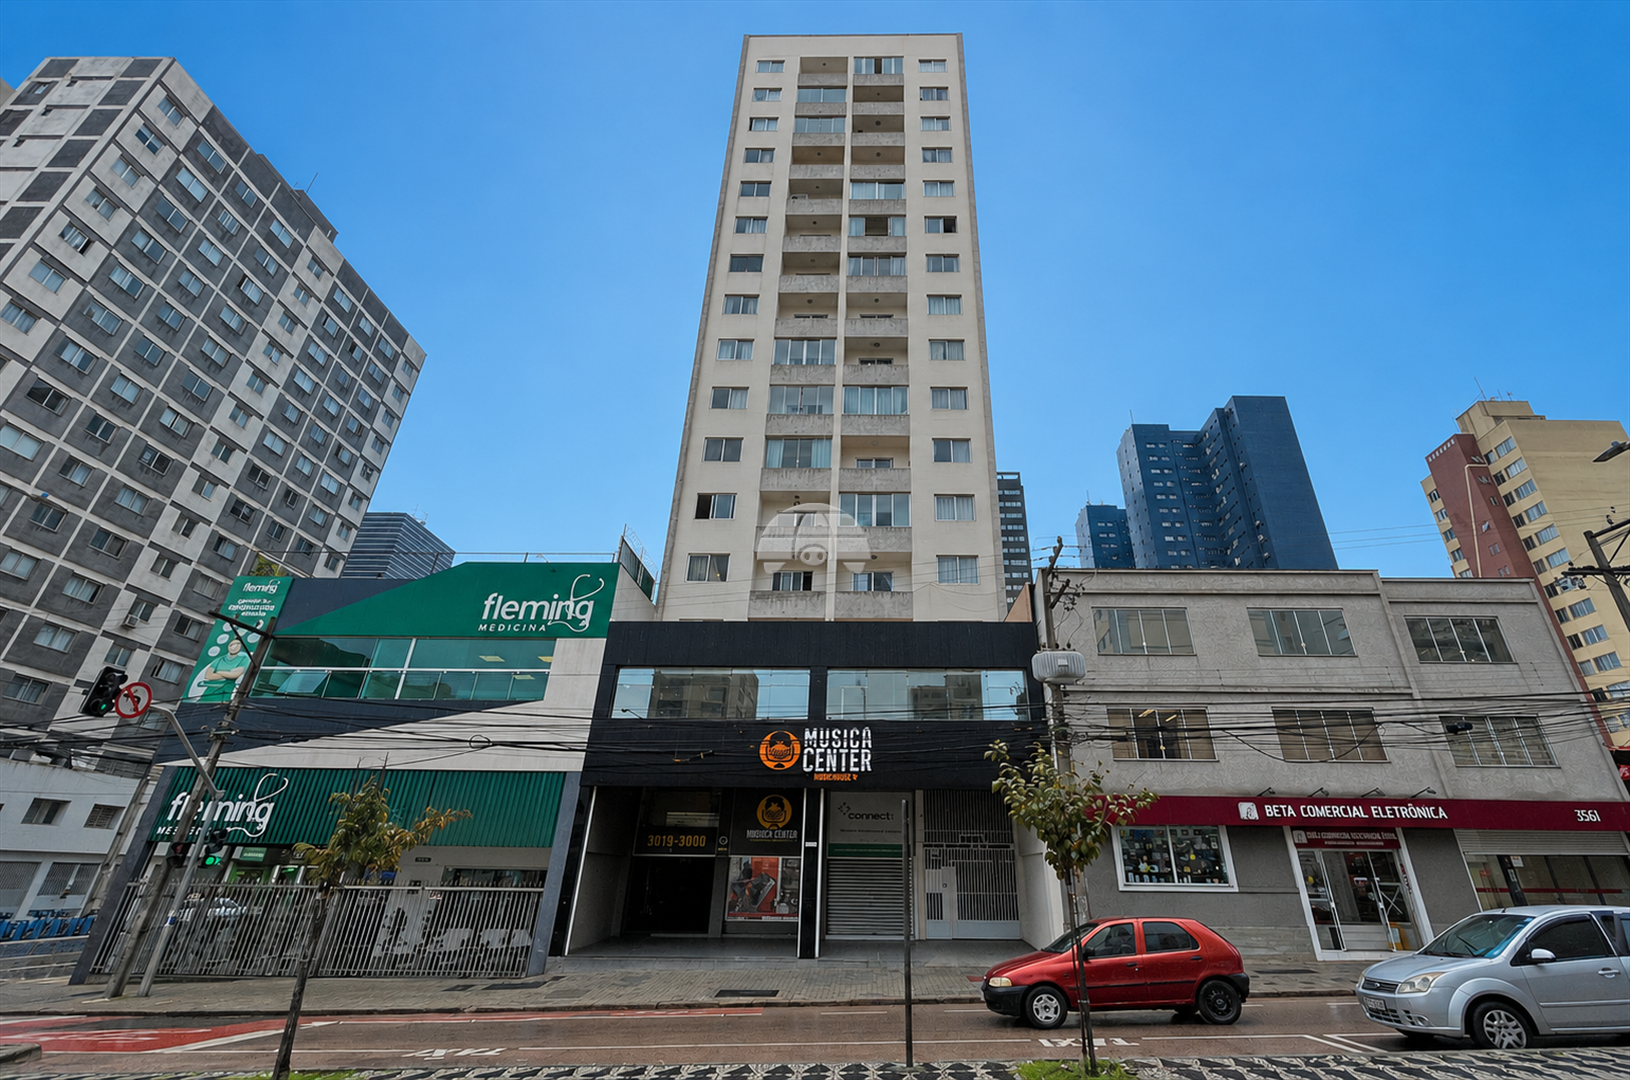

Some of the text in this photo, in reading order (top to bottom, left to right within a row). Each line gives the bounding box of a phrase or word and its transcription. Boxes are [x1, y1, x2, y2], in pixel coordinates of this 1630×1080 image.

[481, 591, 595, 632] fleming
[478, 623, 546, 632] MEDICINA
[803, 726, 872, 748] MUSICA
[802, 748, 872, 772] CENTER
[1264, 803, 1448, 819] BETA COMERCIAL ELETRÔNICA
[1574, 809, 1601, 822] 3561
[647, 834, 707, 848] 3019-3000
